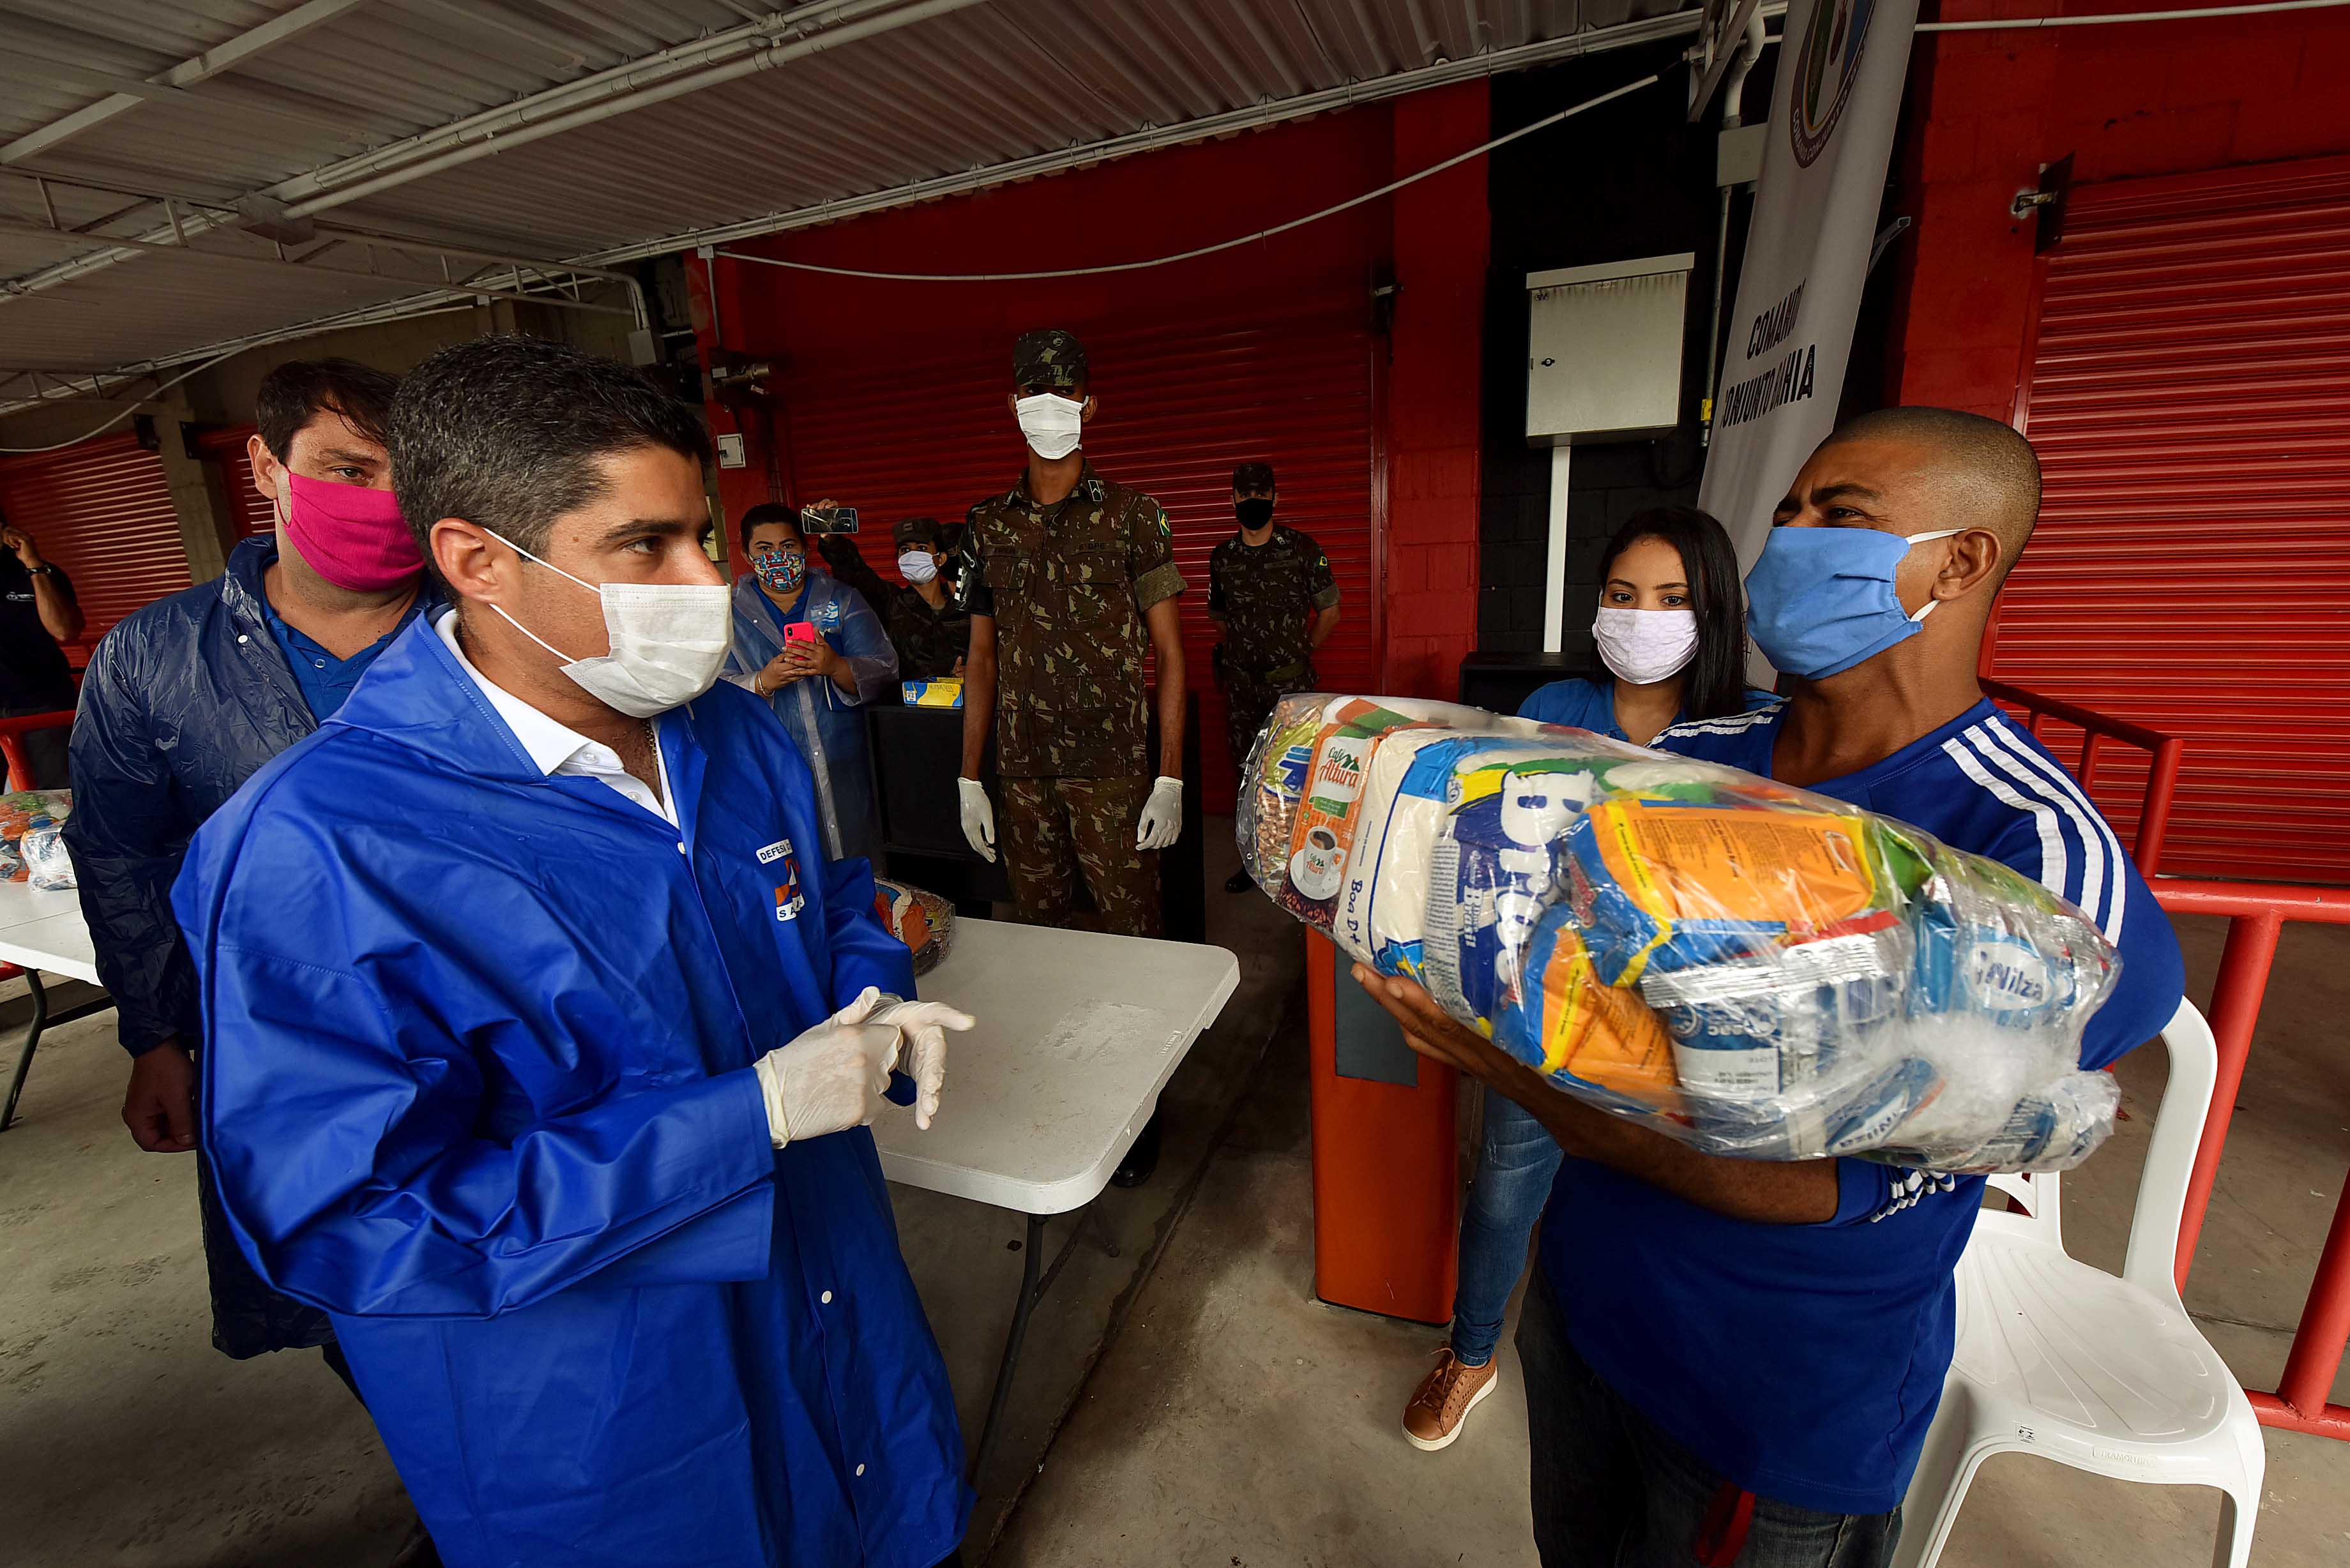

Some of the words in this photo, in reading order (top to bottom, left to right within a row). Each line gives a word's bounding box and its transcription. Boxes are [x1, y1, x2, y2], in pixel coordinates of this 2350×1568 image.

[1720, 366, 1776, 430] ONJUNTO
[1319, 758, 1360, 789] Altura
[1347, 878, 1363, 914] Boa
[1464, 885, 1483, 948] Brasil
